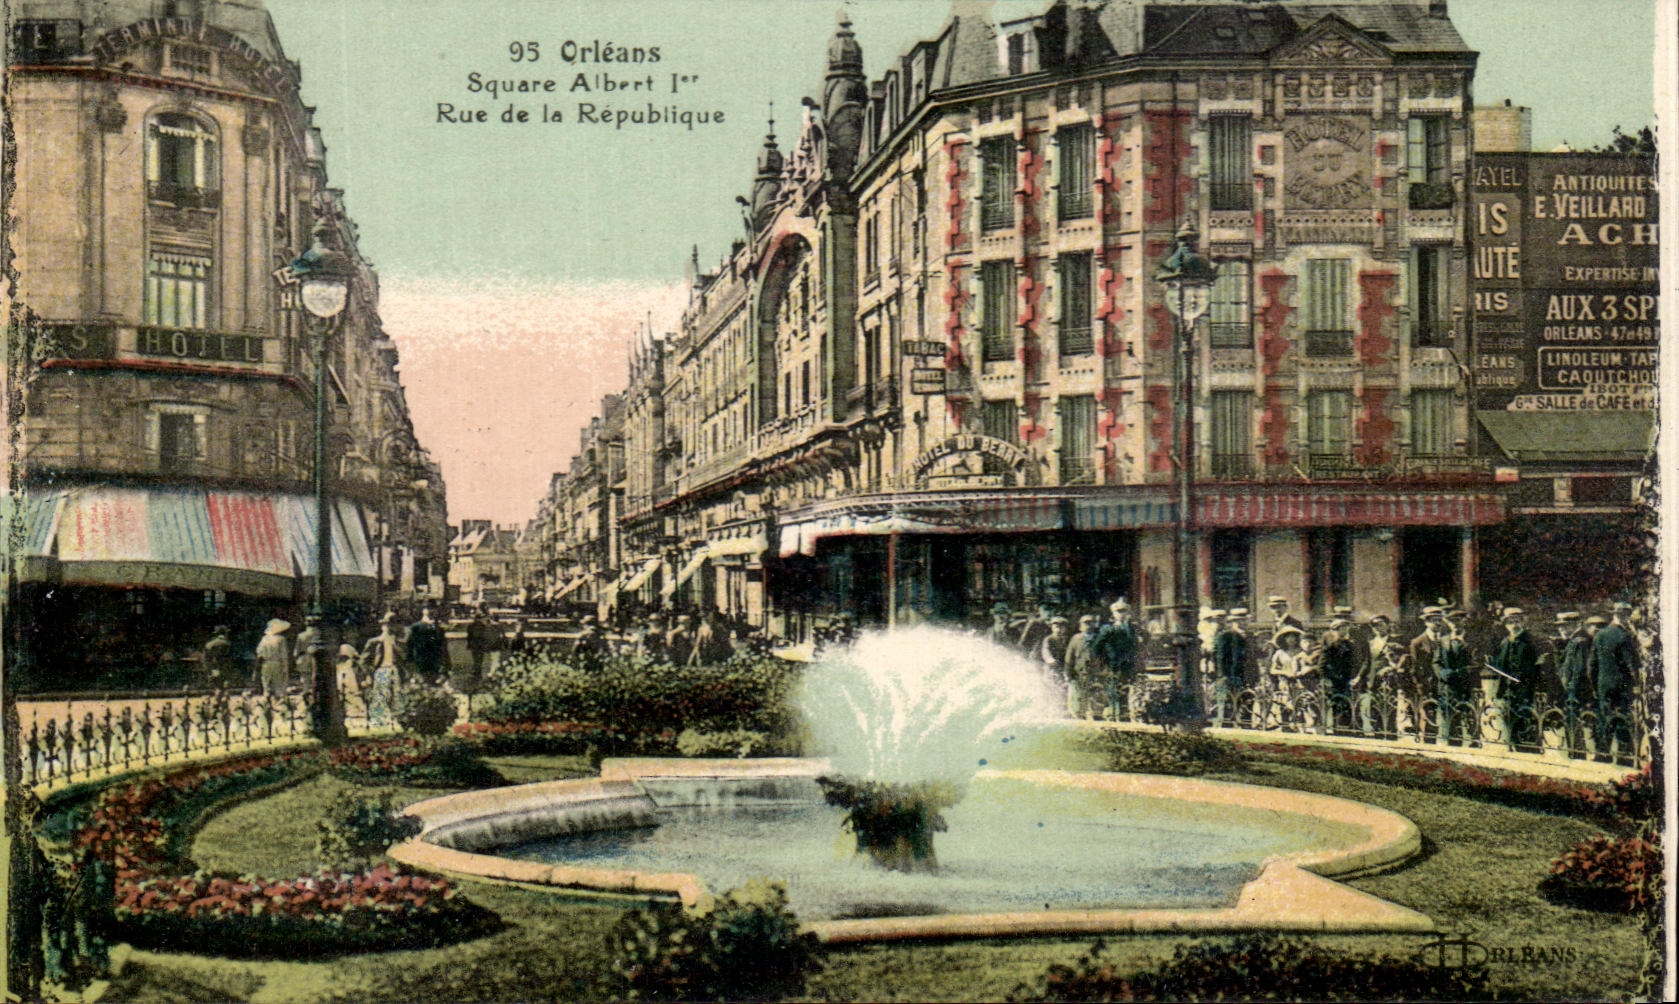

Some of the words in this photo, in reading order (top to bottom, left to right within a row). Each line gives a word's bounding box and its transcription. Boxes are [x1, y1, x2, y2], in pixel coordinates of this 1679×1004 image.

[1473, 166, 1521, 186] AYEL
[1545, 294, 1596, 321] AUX
[1601, 294, 1618, 321] 3
[145, 328, 259, 362] HOTEL
[906, 341, 945, 356] TABAC
[1547, 352, 1622, 366] LINOLEUM
[1536, 396, 1576, 410] SALLE
[957, 434, 975, 450] DU
